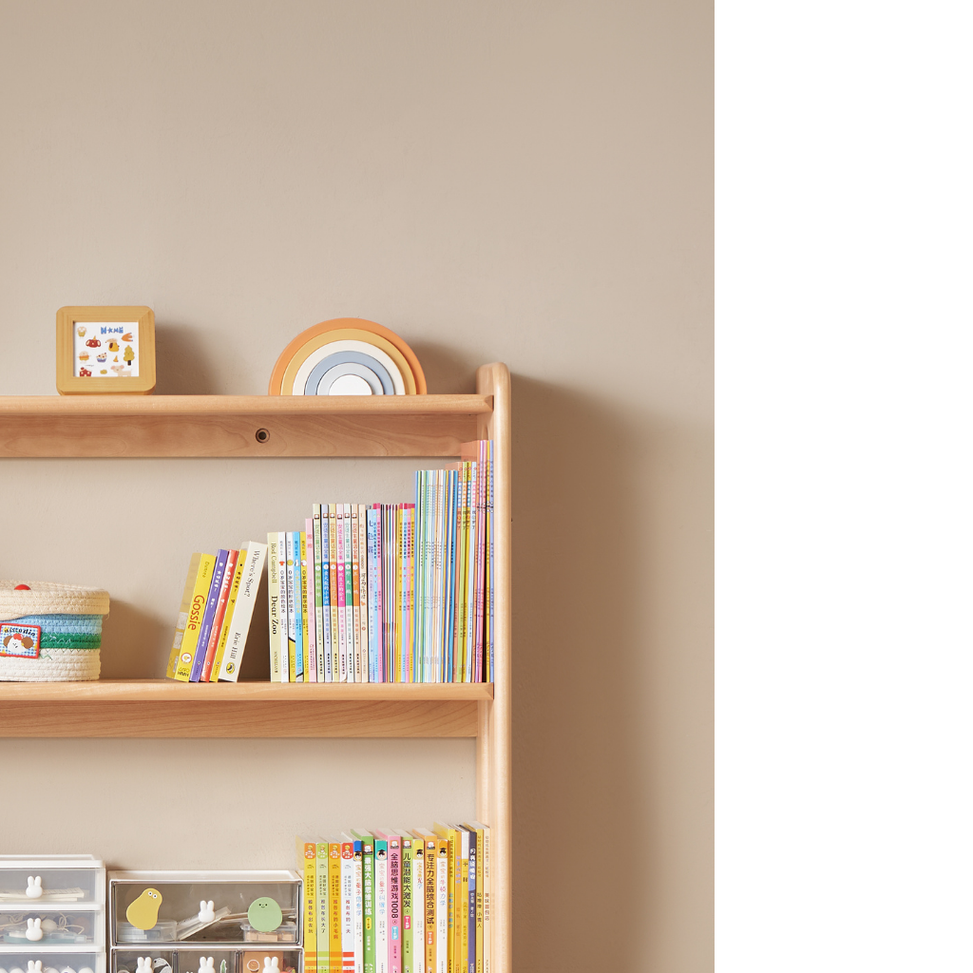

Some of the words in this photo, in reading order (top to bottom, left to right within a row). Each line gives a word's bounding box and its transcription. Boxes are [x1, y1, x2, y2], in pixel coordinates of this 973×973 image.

[390, 852, 399, 919] 全脑思维游戏1008
[403, 852, 411, 908] 儿童潜能大激发
[426, 854, 435, 925] 专注力全脑综合测试
